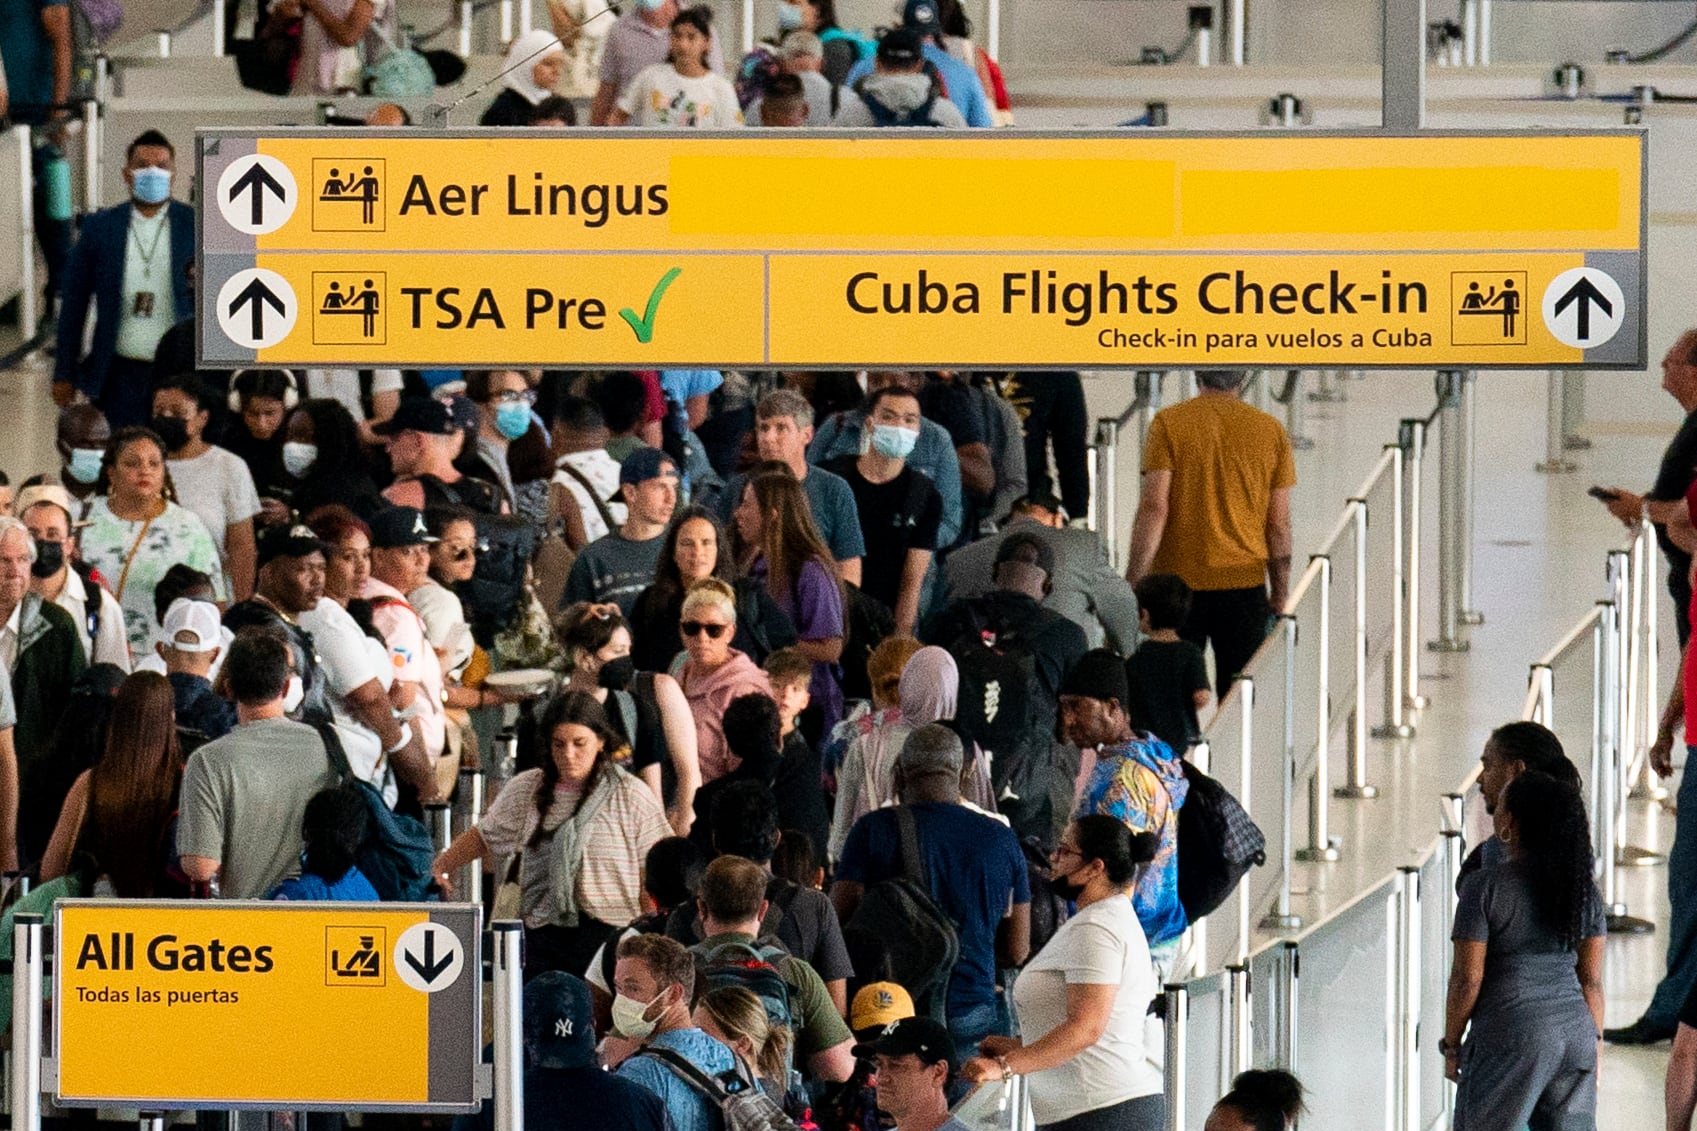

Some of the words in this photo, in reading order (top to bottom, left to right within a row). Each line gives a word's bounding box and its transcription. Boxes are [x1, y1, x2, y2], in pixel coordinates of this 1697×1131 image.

[399, 174, 489, 216] Aer
[507, 172, 669, 228] Lingus
[400, 287, 506, 329] TSA
[525, 288, 607, 330] Pre
[845, 270, 980, 315] Cuba
[1002, 270, 1178, 326] Flights
[1198, 270, 1429, 315] Check-in
[1097, 328, 1198, 349] Check-in
[1205, 332, 1258, 353] para
[1266, 328, 1343, 349] vuelos
[1350, 333, 1364, 348] a
[1372, 328, 1433, 348] Cuba
[76, 932, 134, 970] All
[147, 934, 274, 973] Gates
[76, 986, 129, 1003] Todas
[136, 986, 161, 1003] las
[168, 988, 239, 1007] puertas
[555, 1018, 573, 1037] NY
